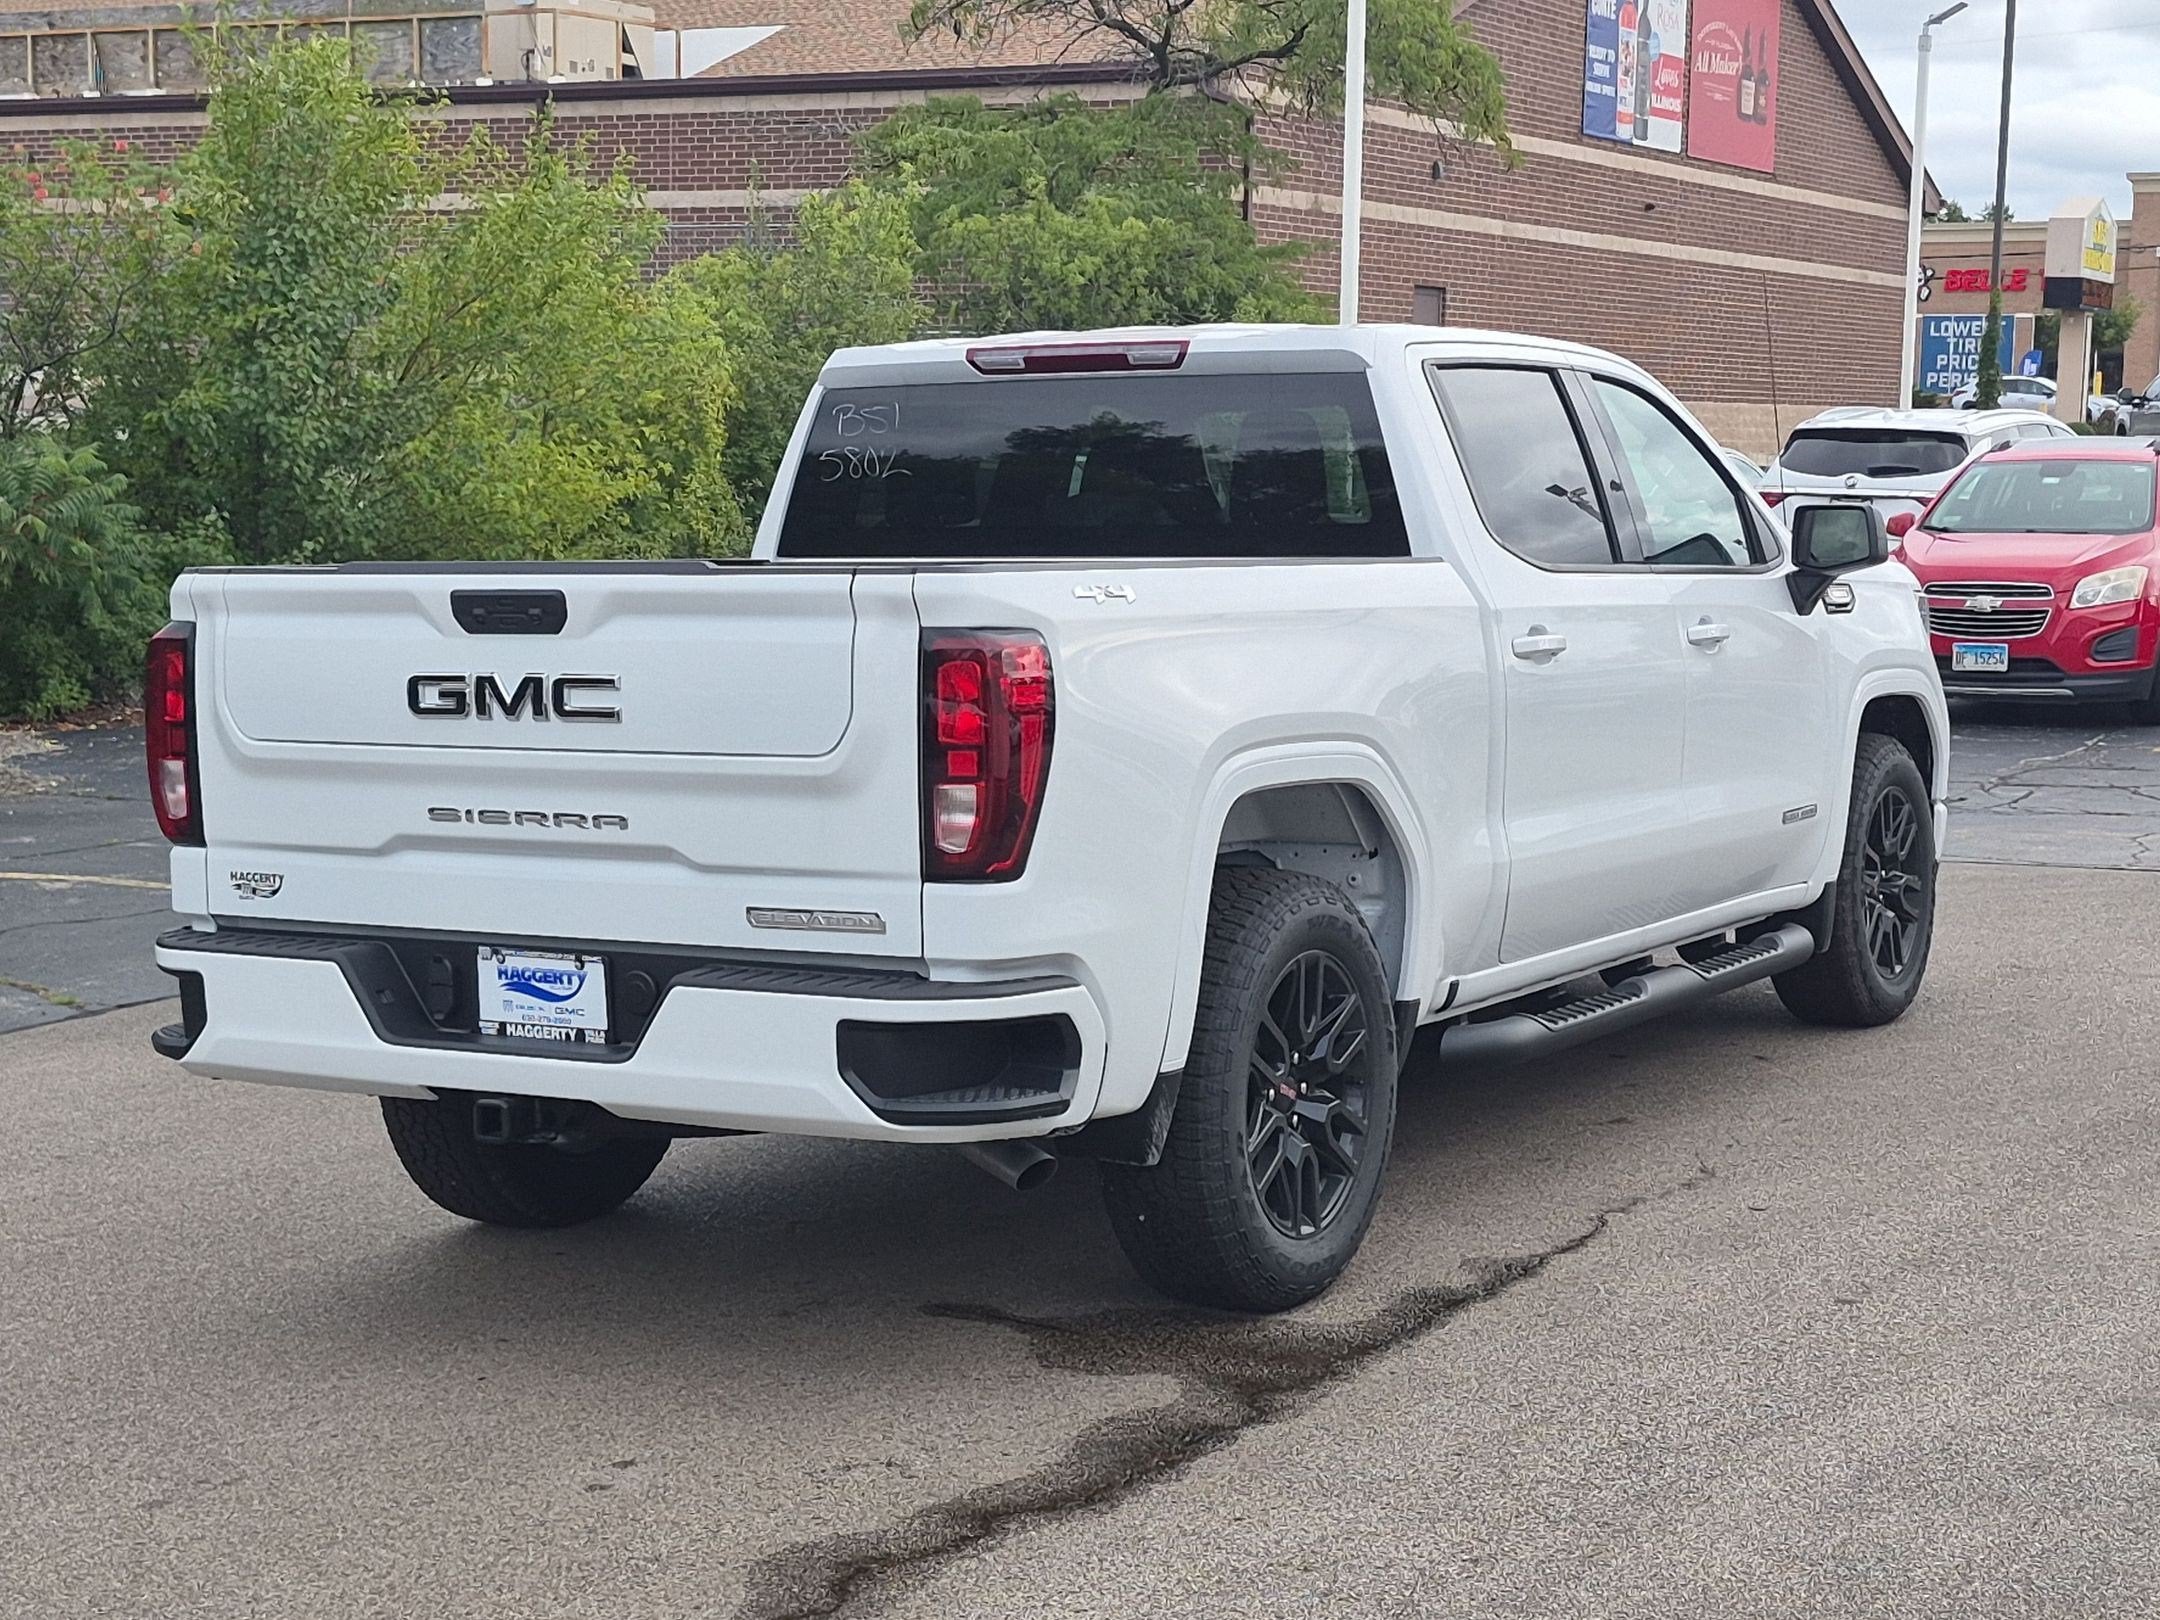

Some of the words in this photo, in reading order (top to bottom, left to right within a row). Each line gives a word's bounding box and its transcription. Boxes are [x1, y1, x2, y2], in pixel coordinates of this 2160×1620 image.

[406, 671, 623, 725] GMC
[427, 806, 630, 831] SIERRA
[754, 911, 877, 929] ELEVATION
[497, 966, 588, 986] HAGGERTY
[506, 1023, 578, 1042] HAGGERTY
